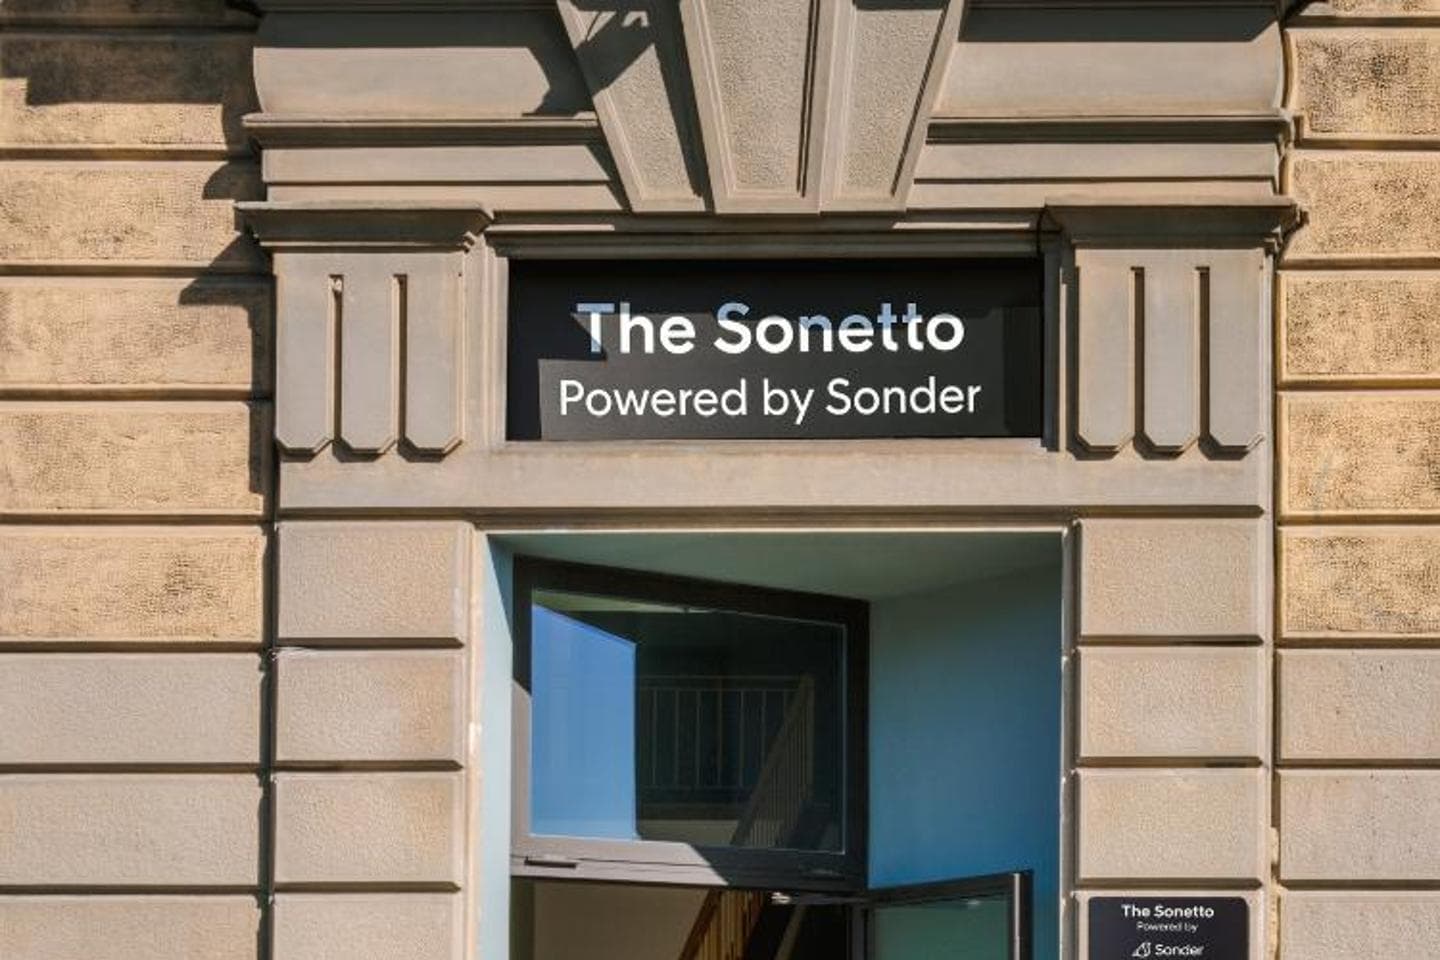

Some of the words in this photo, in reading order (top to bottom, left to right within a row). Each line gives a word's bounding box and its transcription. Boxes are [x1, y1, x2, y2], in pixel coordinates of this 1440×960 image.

[576, 302, 695, 354] The
[714, 302, 965, 354] Sonetto
[560, 377, 747, 417] Powered
[763, 376, 814, 424] by
[826, 376, 982, 416] Sonder
[1121, 905, 1150, 918] The
[1154, 905, 1215, 918] Sonetto
[1136, 921, 1182, 931] Powered
[1155, 943, 1204, 957] Sonder
